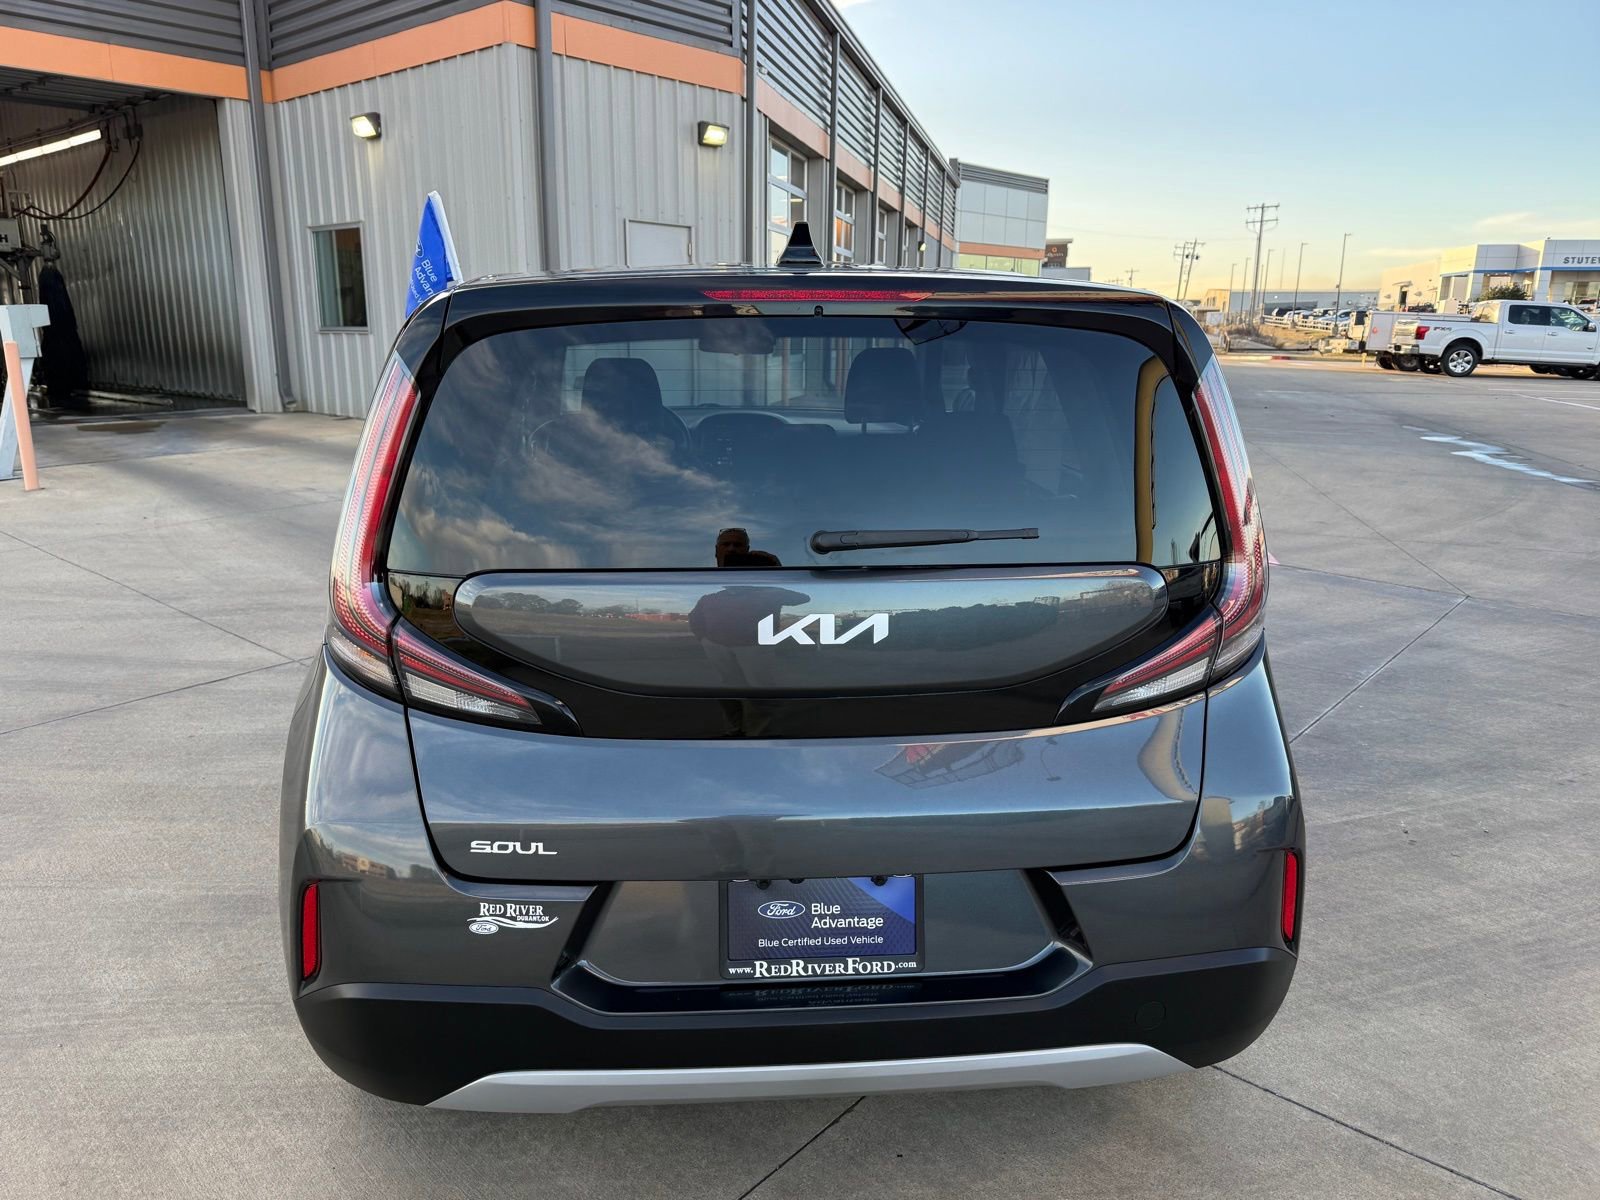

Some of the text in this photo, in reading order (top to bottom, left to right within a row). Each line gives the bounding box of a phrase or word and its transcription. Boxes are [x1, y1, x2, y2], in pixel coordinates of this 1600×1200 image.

[421, 259, 438, 282] Blue
[415, 267, 435, 295] Advan
[758, 613, 889, 645] KIA
[470, 840, 557, 854] SOUL
[811, 903, 841, 914] Blue
[811, 917, 884, 929] Advantage
[758, 935, 884, 947] Blue Certified Used Vehicle
